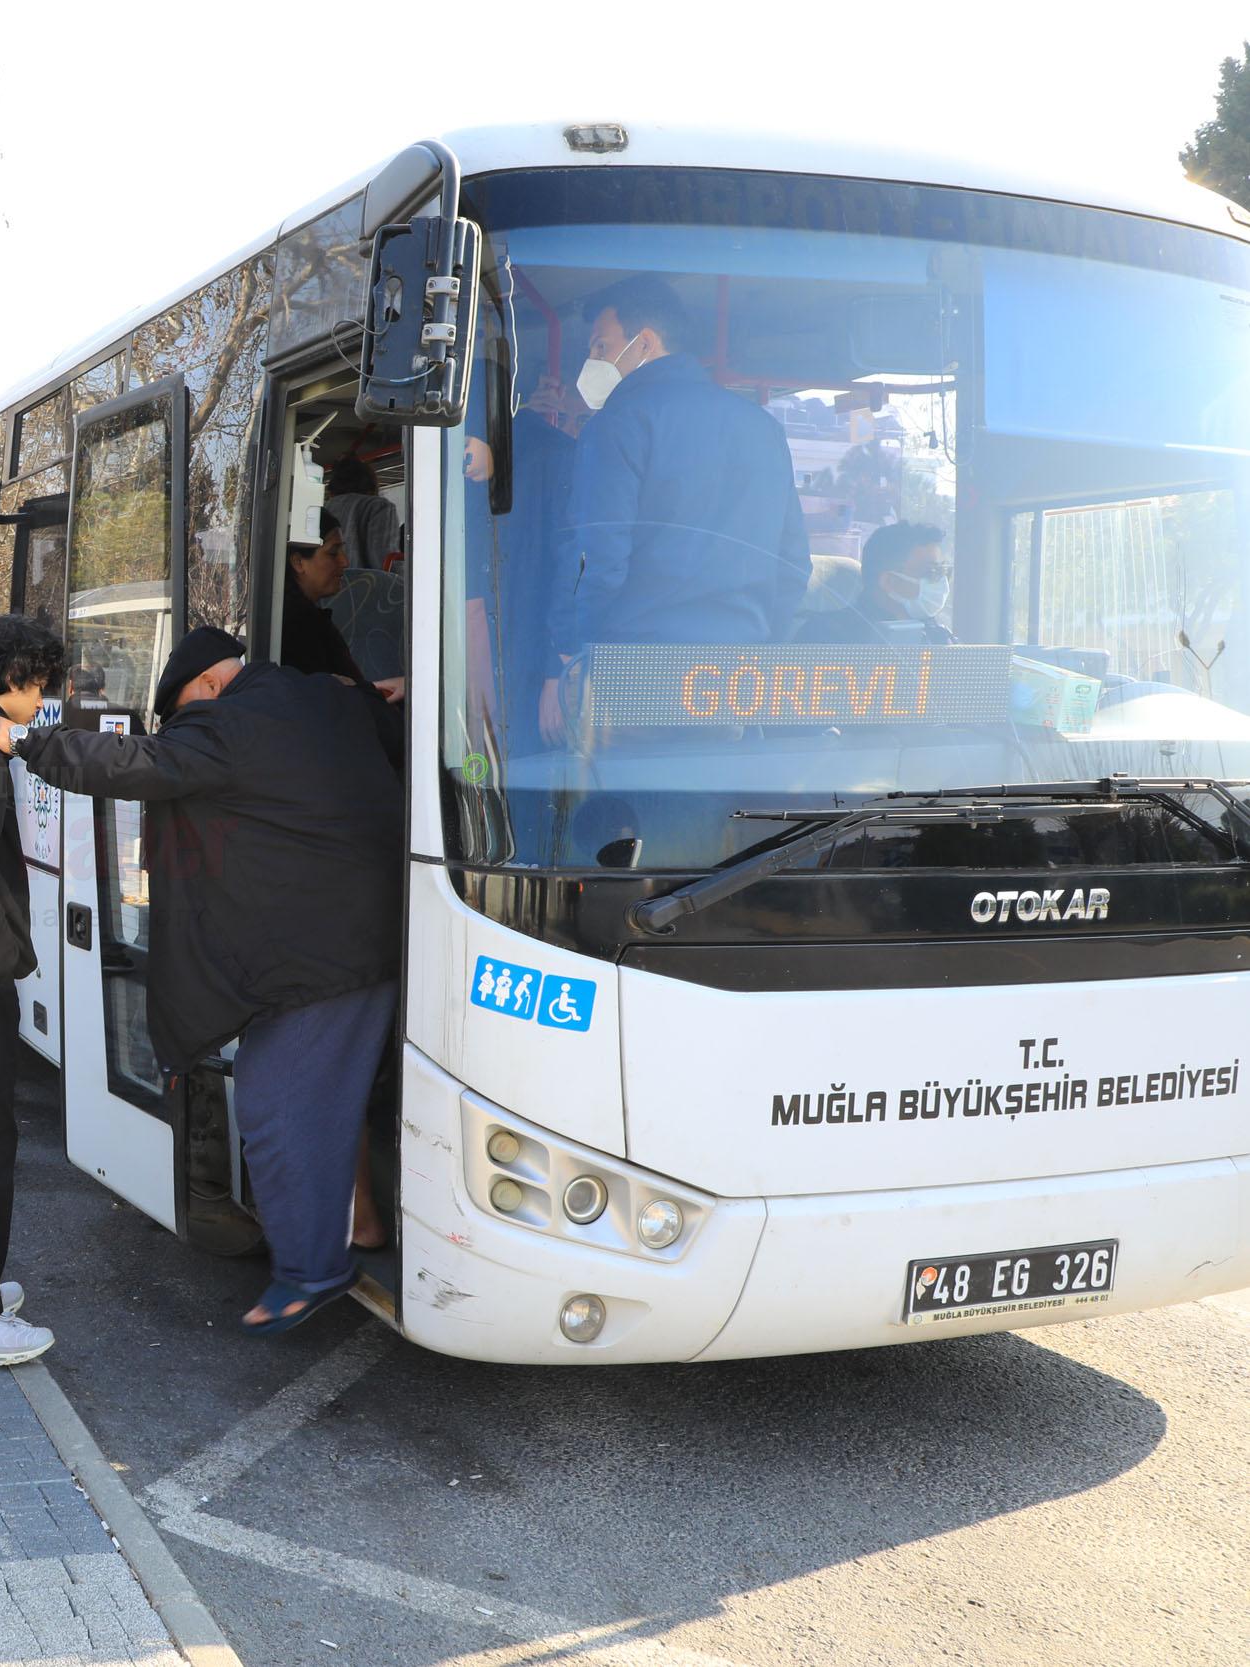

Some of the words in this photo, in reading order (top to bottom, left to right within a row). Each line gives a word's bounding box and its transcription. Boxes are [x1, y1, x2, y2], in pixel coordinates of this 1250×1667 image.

[681, 650, 932, 717] GÖREVLİ
[970, 887, 1111, 923] OTOKAR
[1019, 1037, 1065, 1070] T.C.
[771, 1081, 887, 1126] MUĞLA
[898, 1073, 1088, 1123] BÜYÜKŞEHİR
[1097, 1058, 1240, 1107] BELEDİYESİ
[932, 1264, 971, 1304] 48
[991, 1257, 1031, 1298] EG
[1052, 1249, 1110, 1291] 326
[933, 1310, 963, 1321] MUĞLA
[964, 1303, 1016, 1317] BÜYÜKŞEHİR
[1018, 1297, 1066, 1310] BELEDİYESİ
